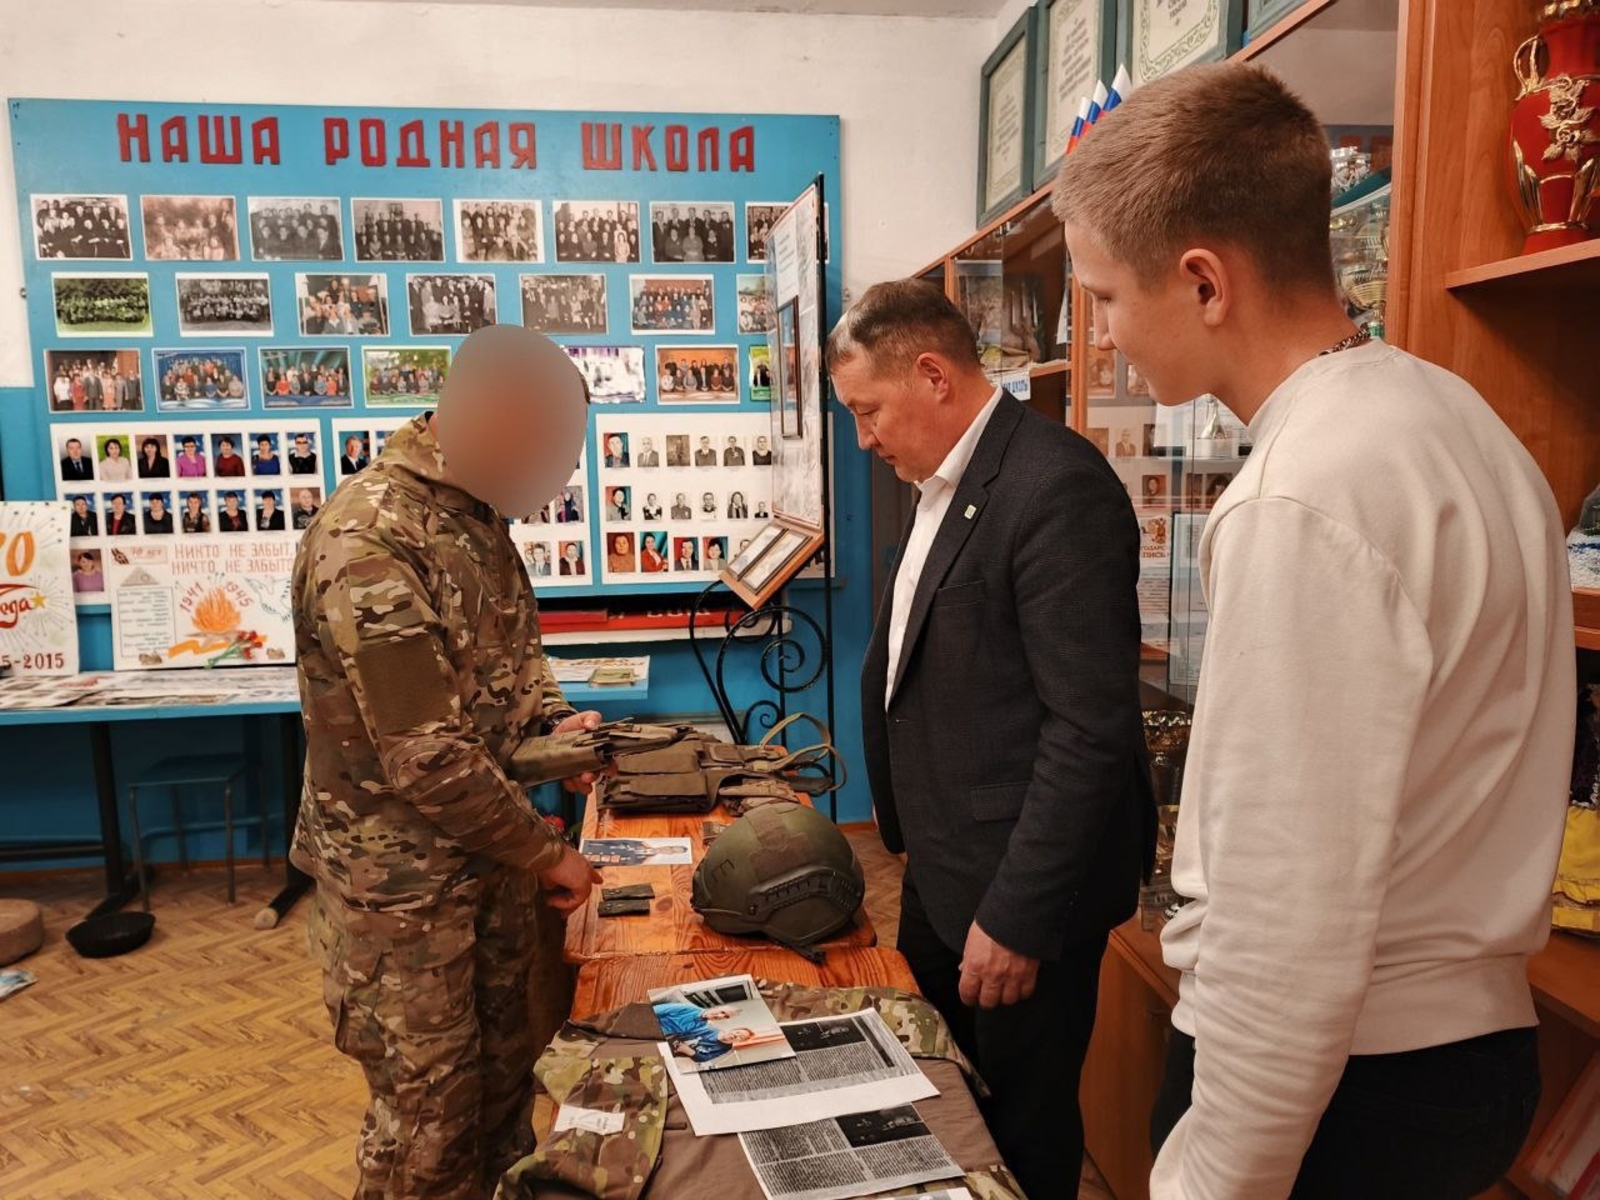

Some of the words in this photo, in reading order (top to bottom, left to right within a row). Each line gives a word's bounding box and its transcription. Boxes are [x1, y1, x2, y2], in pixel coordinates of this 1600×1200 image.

[118, 115, 278, 163] НАША
[325, 118, 534, 166] РОДНАЯ
[583, 124, 753, 170] ШКОЛА
[174, 543, 220, 559] НИКТО
[229, 542, 246, 557] НЕ
[225, 559, 241, 572] НЕ
[180, 582, 204, 613] 1941
